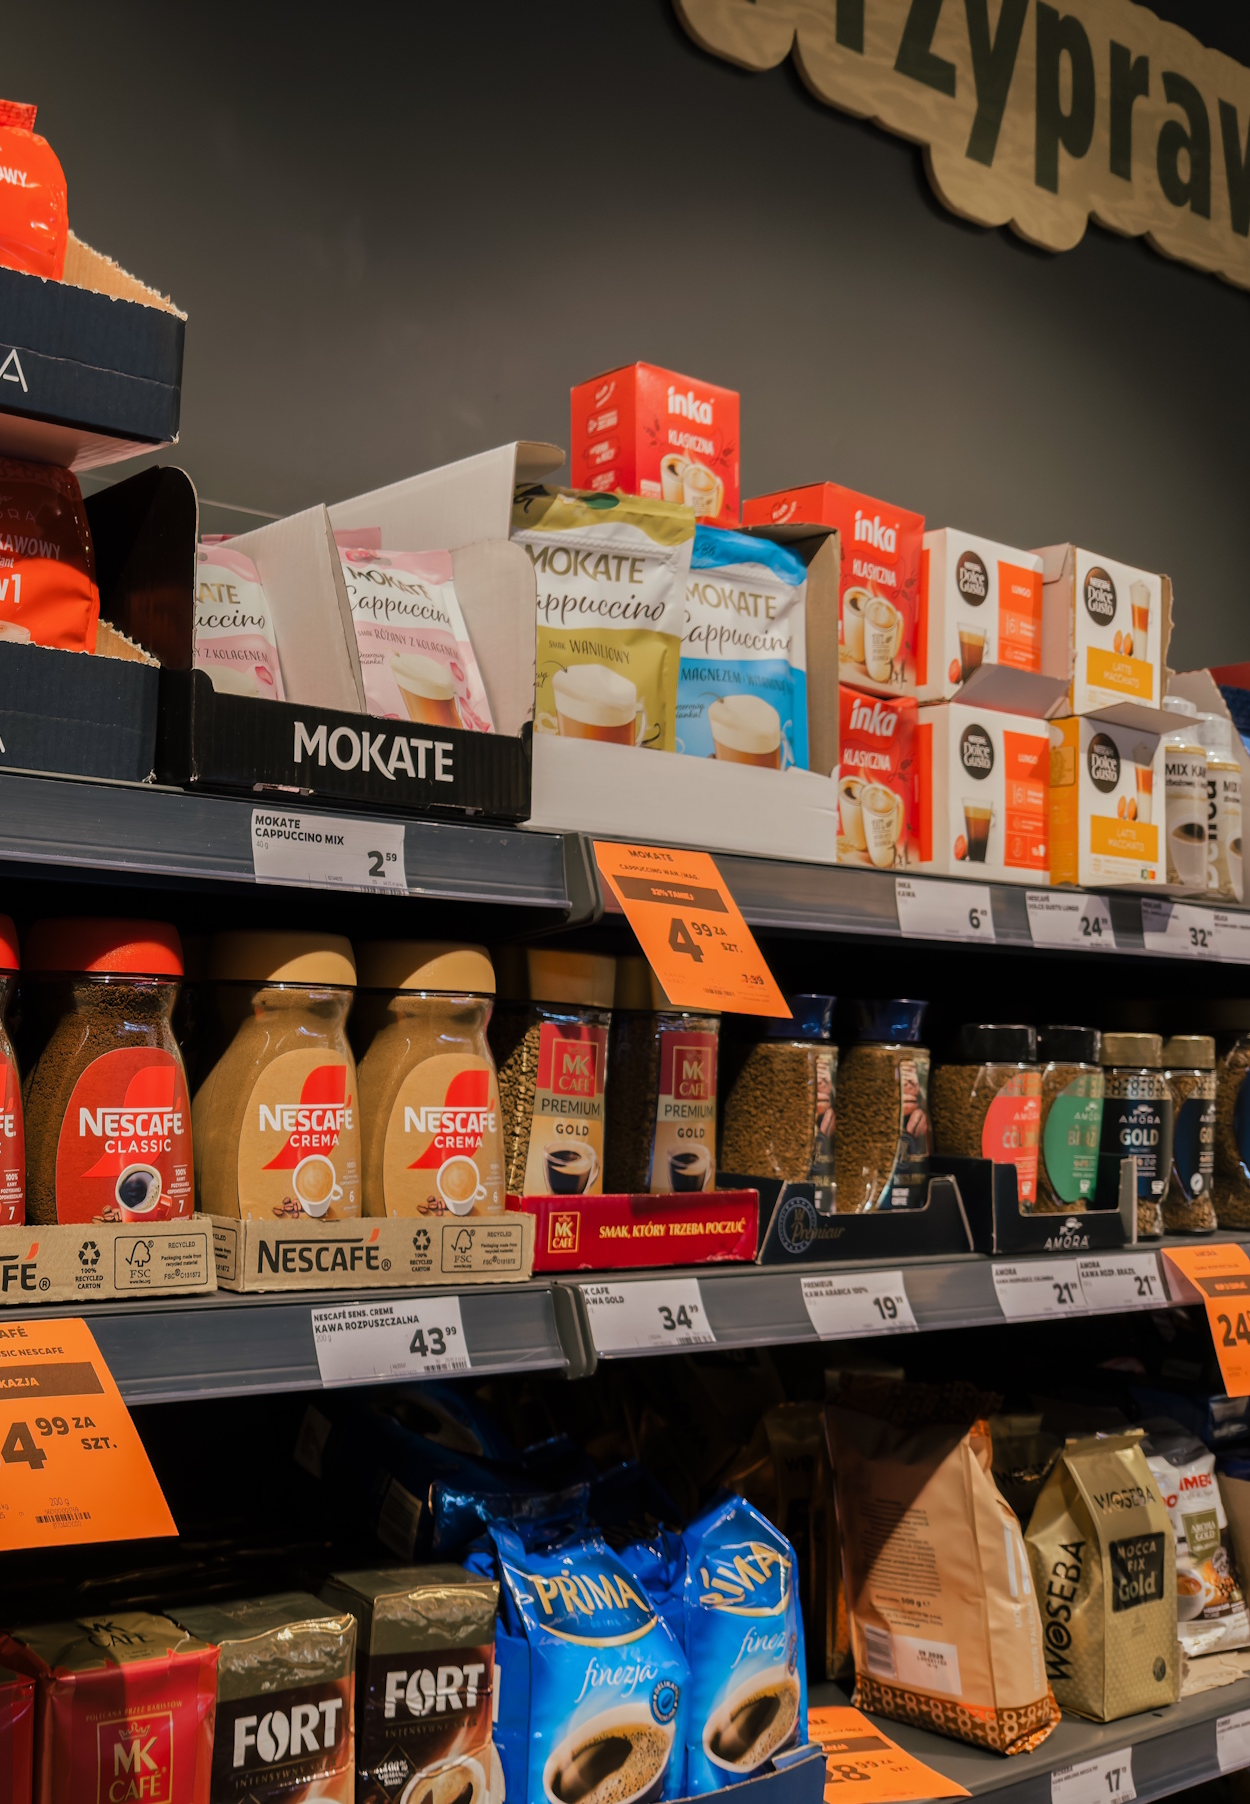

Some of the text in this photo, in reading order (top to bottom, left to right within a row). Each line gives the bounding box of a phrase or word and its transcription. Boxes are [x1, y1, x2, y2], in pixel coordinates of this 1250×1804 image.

[667, 386, 714, 426] inka
[667, 430, 715, 457] KLASYCZNA
[854, 510, 897, 553] inka
[852, 558, 897, 588] KLASYCZNA
[686, 582, 777, 621] MOKATE
[1112, 662, 1133, 675] LATTE
[1103, 670, 1140, 689] MACCHIATO
[850, 698, 898, 737] inka
[293, 720, 455, 783] MOKATE
[843, 748, 892, 772] KLASYCZNA
[255, 815, 301, 829] MOKATE
[255, 827, 344, 846] CAPPUCCINO MIX
[1107, 836, 1145, 853] MACCHIATO
[367, 850, 398, 878] 2 59
[628, 849, 674, 862] MOKATE
[968, 908, 981, 930] 6
[1081, 917, 1102, 937] 24
[668, 917, 727, 963] 4 99 ZA
[1188, 926, 1209, 949] 32
[720, 942, 743, 954] SZT.
[562, 1054, 591, 1076] MK
[682, 1059, 705, 1081] MK
[541, 1098, 600, 1116] PREMIUM
[664, 1104, 713, 1118] PREMIUM
[1118, 1114, 1161, 1124] AMORA
[555, 1124, 590, 1137] GOLD
[677, 1128, 705, 1139] GOLD
[1119, 1128, 1160, 1146] GOLD
[104, 1139, 172, 1154] CLASSIC
[289, 1134, 340, 1148] CREMA
[434, 1135, 483, 1149] CREMA
[554, 1222, 574, 1237] MK
[599, 1217, 746, 1239] SMAK, KTÓRY TRZEBA POCZUĆ
[257, 1228, 381, 1274] NESCAFÉ
[553, 1235, 574, 1249] CAFÉ
[1043, 1235, 1090, 1250] AMORA
[1052, 1283, 1073, 1304] 21
[1134, 1276, 1154, 1296] 21
[313, 1307, 394, 1322] NESCAFÉ SENS. CREME
[657, 1305, 699, 1331] 34 99
[872, 1296, 898, 1320] 19
[315, 1315, 420, 1334] KAWA ROZPUSZCZALNA
[409, 1326, 457, 1357] 43 99
[19, 1347, 64, 1357] NESCAFE
[35, 1416, 70, 1436] 99
[71, 1416, 96, 1429] ZA
[81, 1436, 117, 1450] SZT.
[1094, 1485, 1157, 1511] WOSEBA
[1191, 1521, 1216, 1534] AROMA
[1194, 1530, 1215, 1543] GOLD
[1118, 1541, 1157, 1560] MOCCA
[1126, 1556, 1146, 1572] FIX
[530, 1569, 650, 1616] PRIMA
[1118, 1572, 1156, 1602] Gold
[1046, 1540, 1088, 1680] WOSEBA
[574, 1656, 658, 1704] finezja
[384, 1663, 486, 1719] FORT
[233, 1698, 343, 1768] FORT
[113, 1737, 158, 1776] MK
[1104, 1768, 1121, 1793] 17
